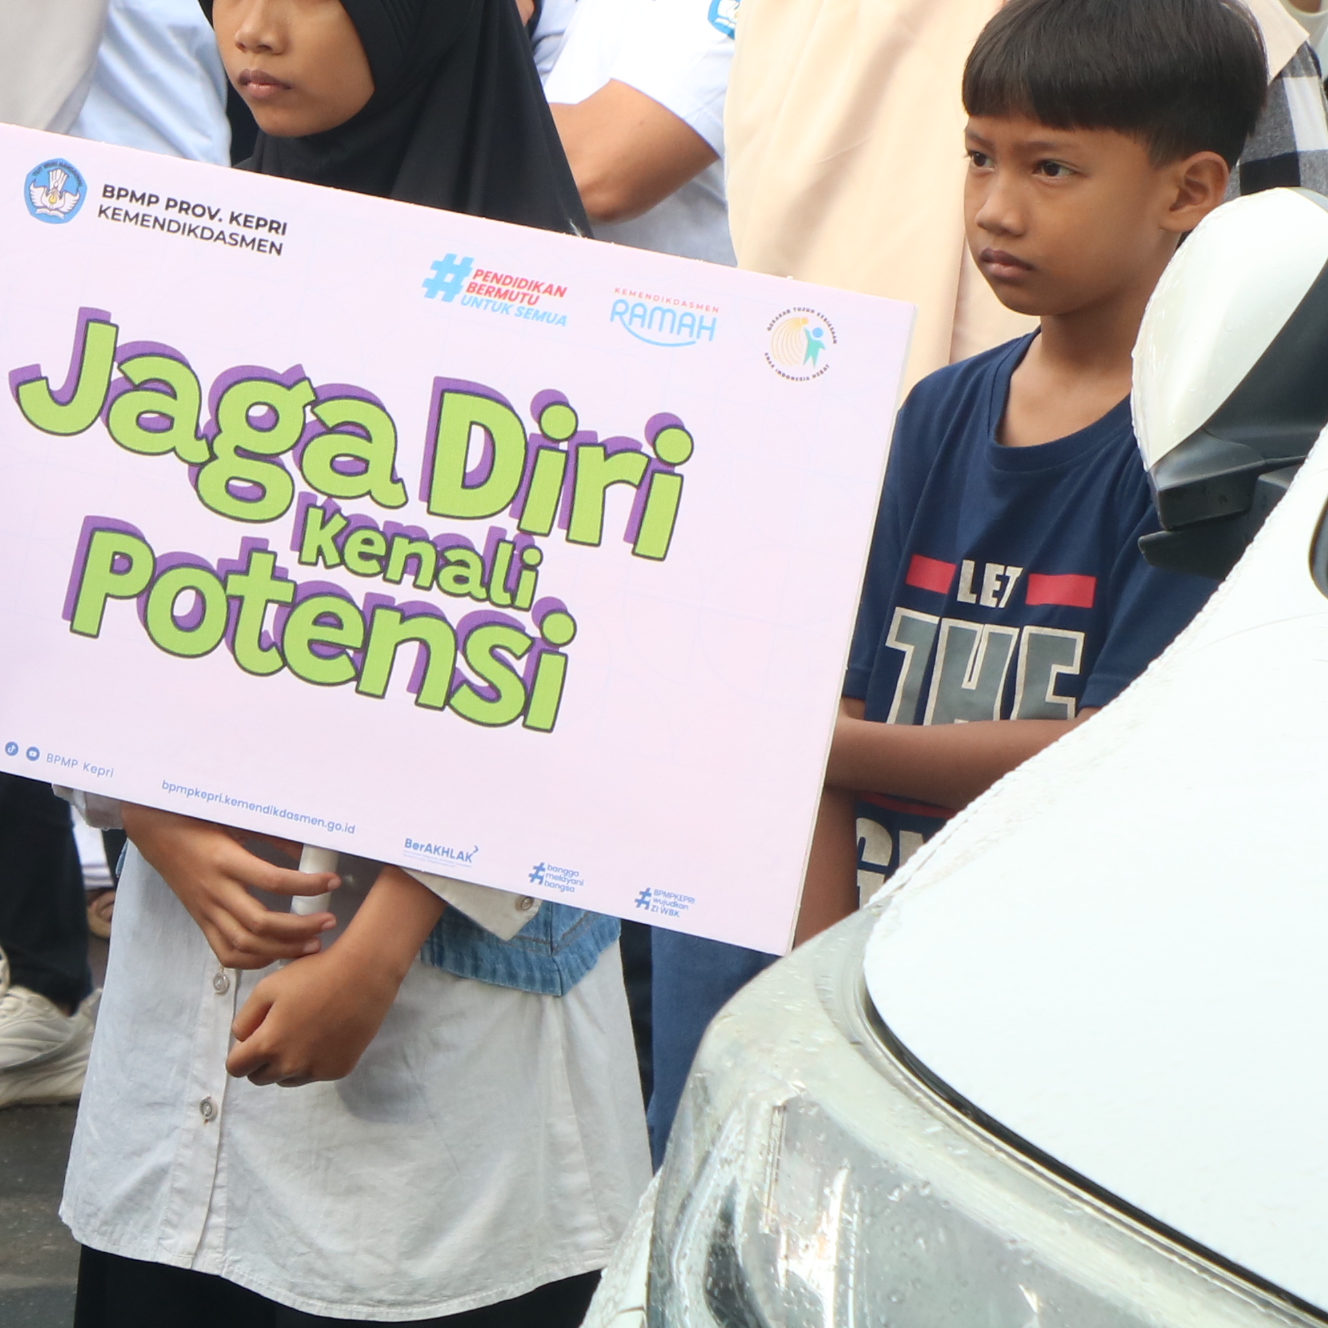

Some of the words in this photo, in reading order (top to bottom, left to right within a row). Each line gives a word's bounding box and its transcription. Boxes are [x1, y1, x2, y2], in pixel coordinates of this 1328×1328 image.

[101, 183, 159, 208] BPMP
[165, 197, 223, 222] PROV.
[229, 211, 288, 236] KEPRI
[98, 204, 283, 256] KEMENDIKDASMEN
[465, 282, 540, 306] BERMUTU
[472, 269, 568, 298] PENDIDIKAN
[461, 294, 511, 315] UNTUK
[514, 306, 568, 327] SEMUA
[614, 287, 720, 313] KEMENDIKDASMEN
[610, 298, 718, 343] RAMAH
[8, 306, 408, 522] Jaga
[419, 376, 694, 561] Diri
[62, 515, 577, 734] Potensi
[46, 753, 78, 769] BPMP
[83, 762, 115, 778] Kepri
[161, 779, 356, 834] bpmpkepri.kemendikdasmen.go.id
[404, 837, 474, 863] BerAKHLAK
[545, 872, 584, 886] melayani
[547, 864, 579, 878] bangga
[544, 880, 575, 893] bangsa
[660, 906, 680, 918] WBK
